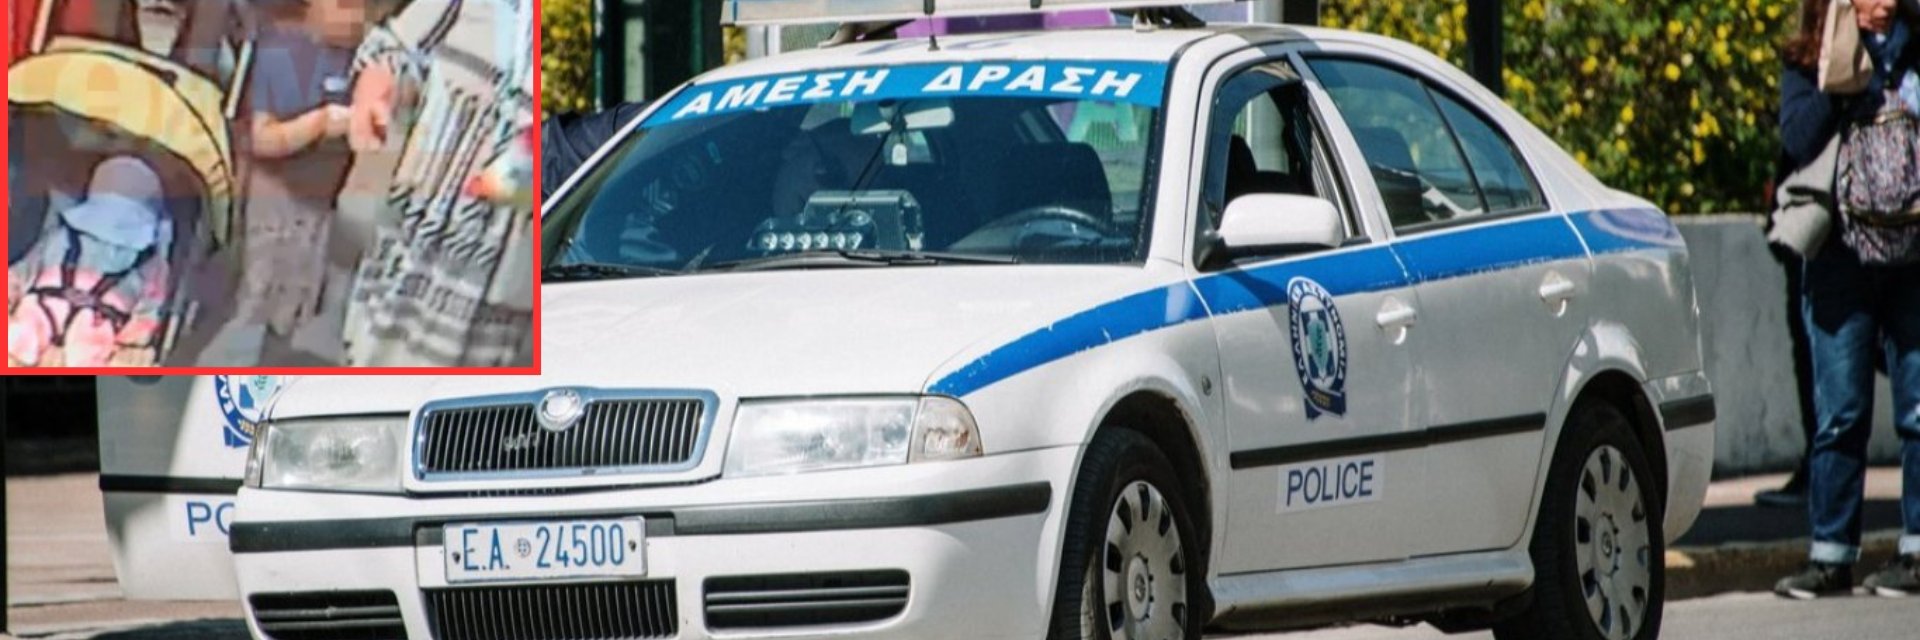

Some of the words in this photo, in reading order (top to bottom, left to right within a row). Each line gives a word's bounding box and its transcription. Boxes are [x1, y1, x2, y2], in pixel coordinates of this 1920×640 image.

[672, 69, 890, 120] ΑΜΕΣΗ
[922, 66, 1142, 97] ΔΡΑΣΗ
[1286, 460, 1374, 507] POLICE
[536, 523, 624, 569] 24500
